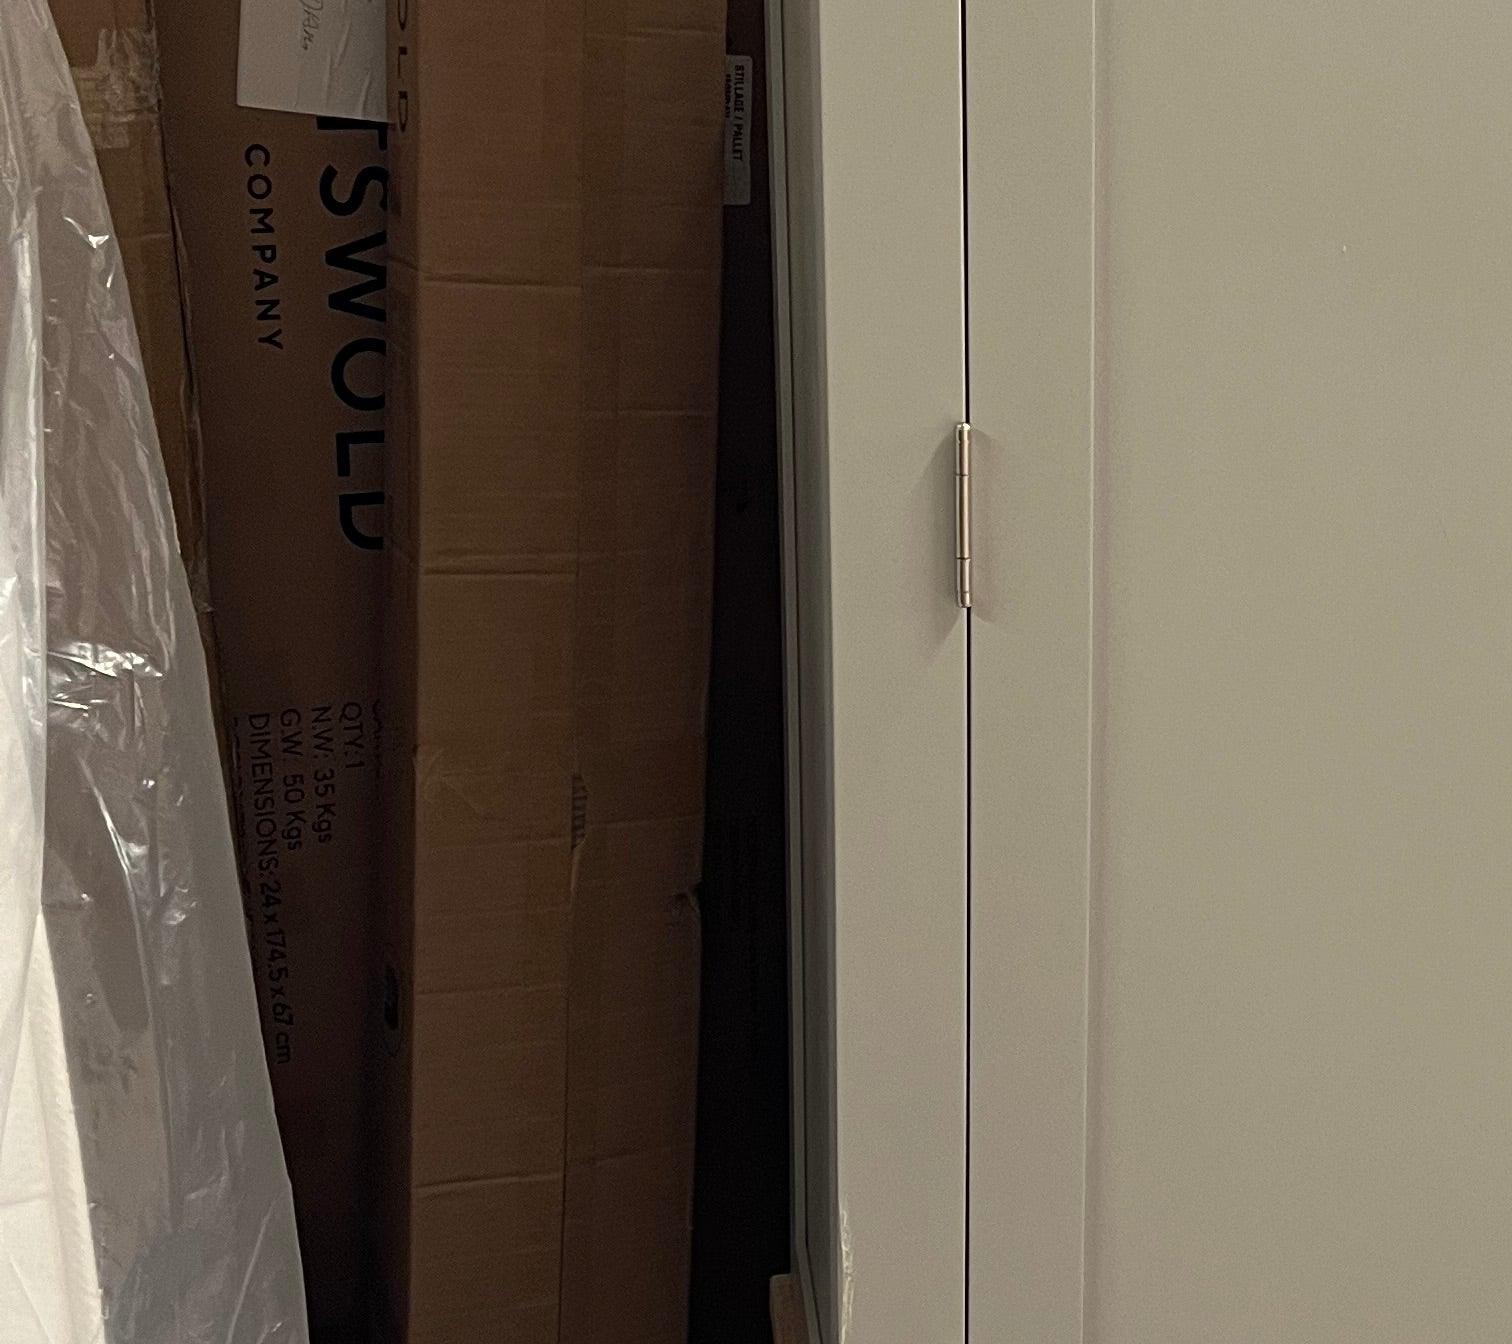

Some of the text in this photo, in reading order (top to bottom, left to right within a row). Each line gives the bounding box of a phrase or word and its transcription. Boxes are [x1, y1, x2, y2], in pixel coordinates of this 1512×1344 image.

[244, 143, 284, 350] COMPANY
[248, 712, 279, 879] DIMENSIONS:
[283, 773, 305, 804] 50
[314, 768, 337, 798] 35
[281, 810, 307, 851] Kgs
[312, 803, 337, 844] Kgs
[260, 881, 282, 907] 24
[264, 913, 280, 925] x
[270, 987, 287, 999] x
[276, 1032, 292, 1065] cm
